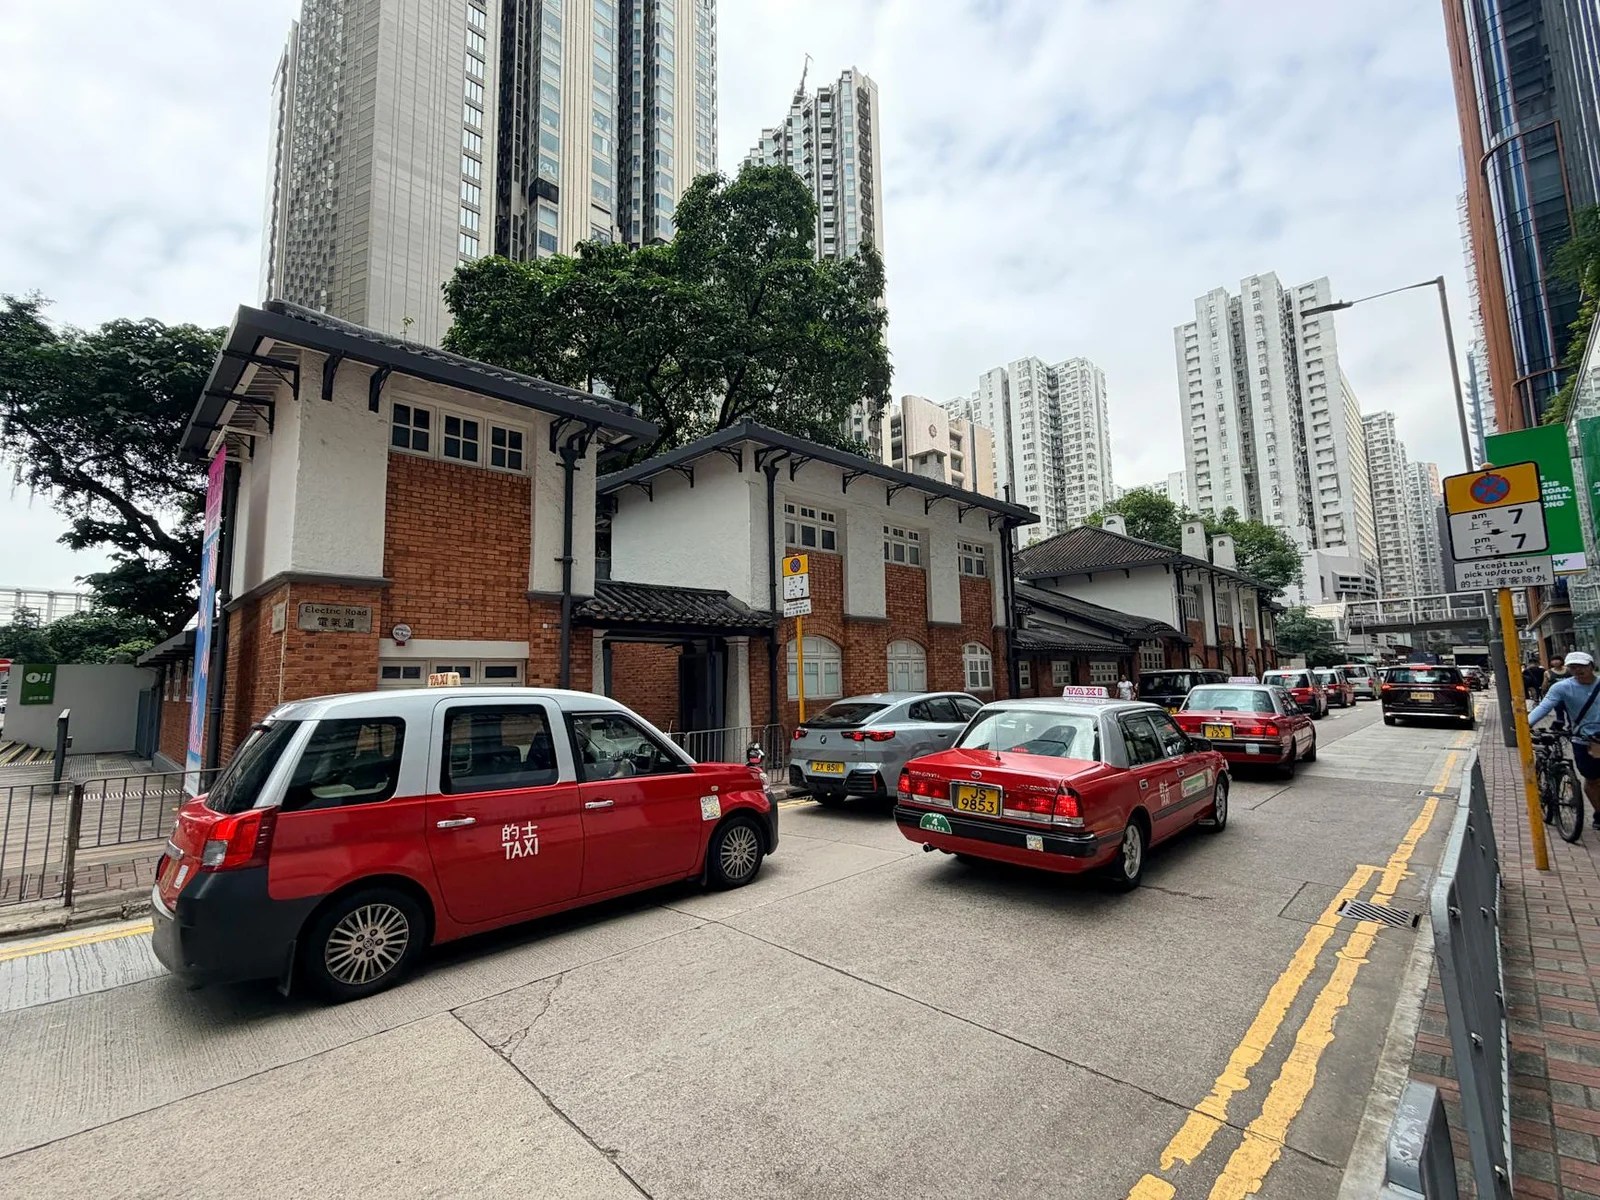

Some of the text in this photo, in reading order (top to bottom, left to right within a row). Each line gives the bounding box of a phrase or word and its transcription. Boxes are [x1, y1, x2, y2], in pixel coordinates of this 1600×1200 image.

[1471, 508, 1523, 524] am 7
[1468, 520, 1493, 530] 上午
[1474, 533, 1527, 549] pm 7
[1470, 544, 1497, 555] 下午
[1474, 561, 1507, 570] Except
[1464, 571, 1482, 579] pick
[1484, 568, 1524, 577] up/drop
[304, 605, 368, 616] Electric Road
[429, 673, 448, 686] TAXI
[1066, 687, 1103, 696] TAXI
[970, 789, 987, 800] JS
[961, 798, 995, 813] 9853
[931, 818, 938, 826] 4
[501, 820, 539, 842] 的士
[501, 837, 539, 860] TAXI
